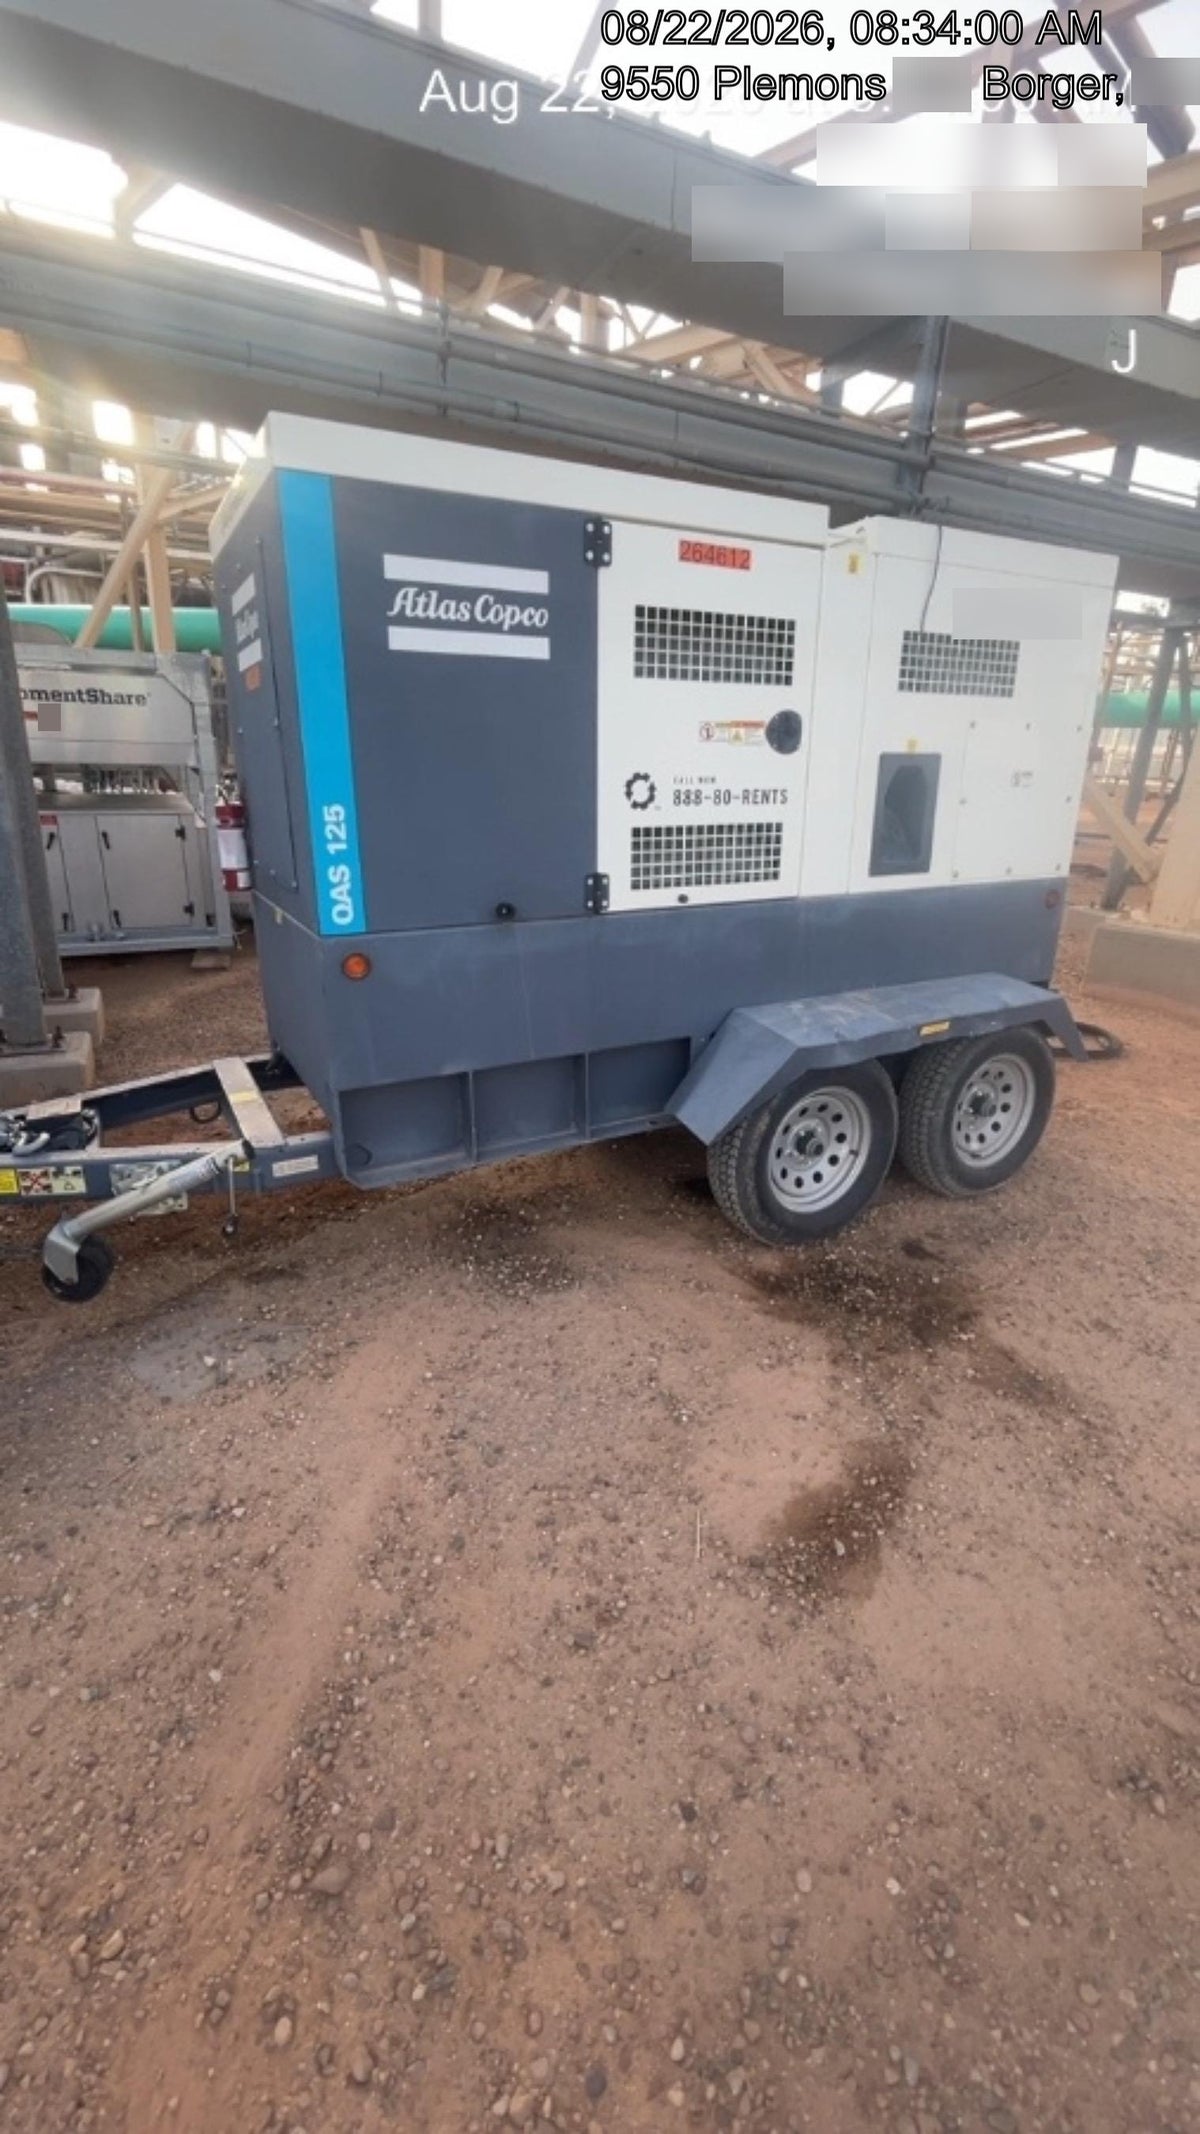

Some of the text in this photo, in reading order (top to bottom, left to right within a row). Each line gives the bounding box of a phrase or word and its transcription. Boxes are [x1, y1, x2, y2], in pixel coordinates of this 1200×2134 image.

[679, 540, 751, 571] 264612
[386, 587, 549, 631] Atlas Copco
[672, 788, 789, 807] 888-80-RENTS
[322, 803, 348, 855] 125
